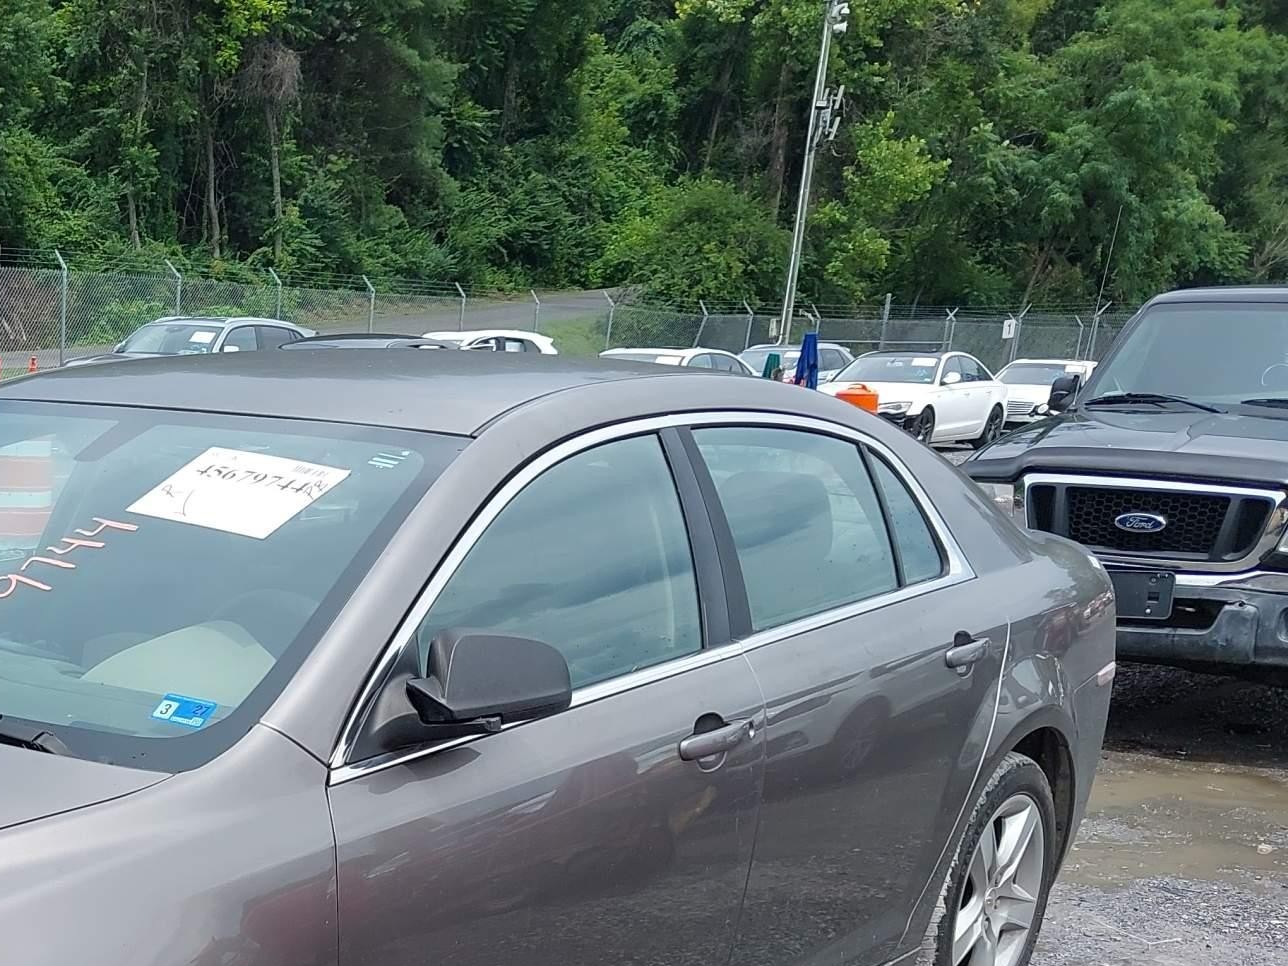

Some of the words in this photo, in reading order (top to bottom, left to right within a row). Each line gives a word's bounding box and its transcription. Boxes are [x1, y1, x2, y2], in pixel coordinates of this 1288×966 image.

[196, 464, 309, 493] 45679744
[1125, 516, 1155, 529] Ford
[160, 703, 172, 715] 3
[193, 704, 211, 716] 27
